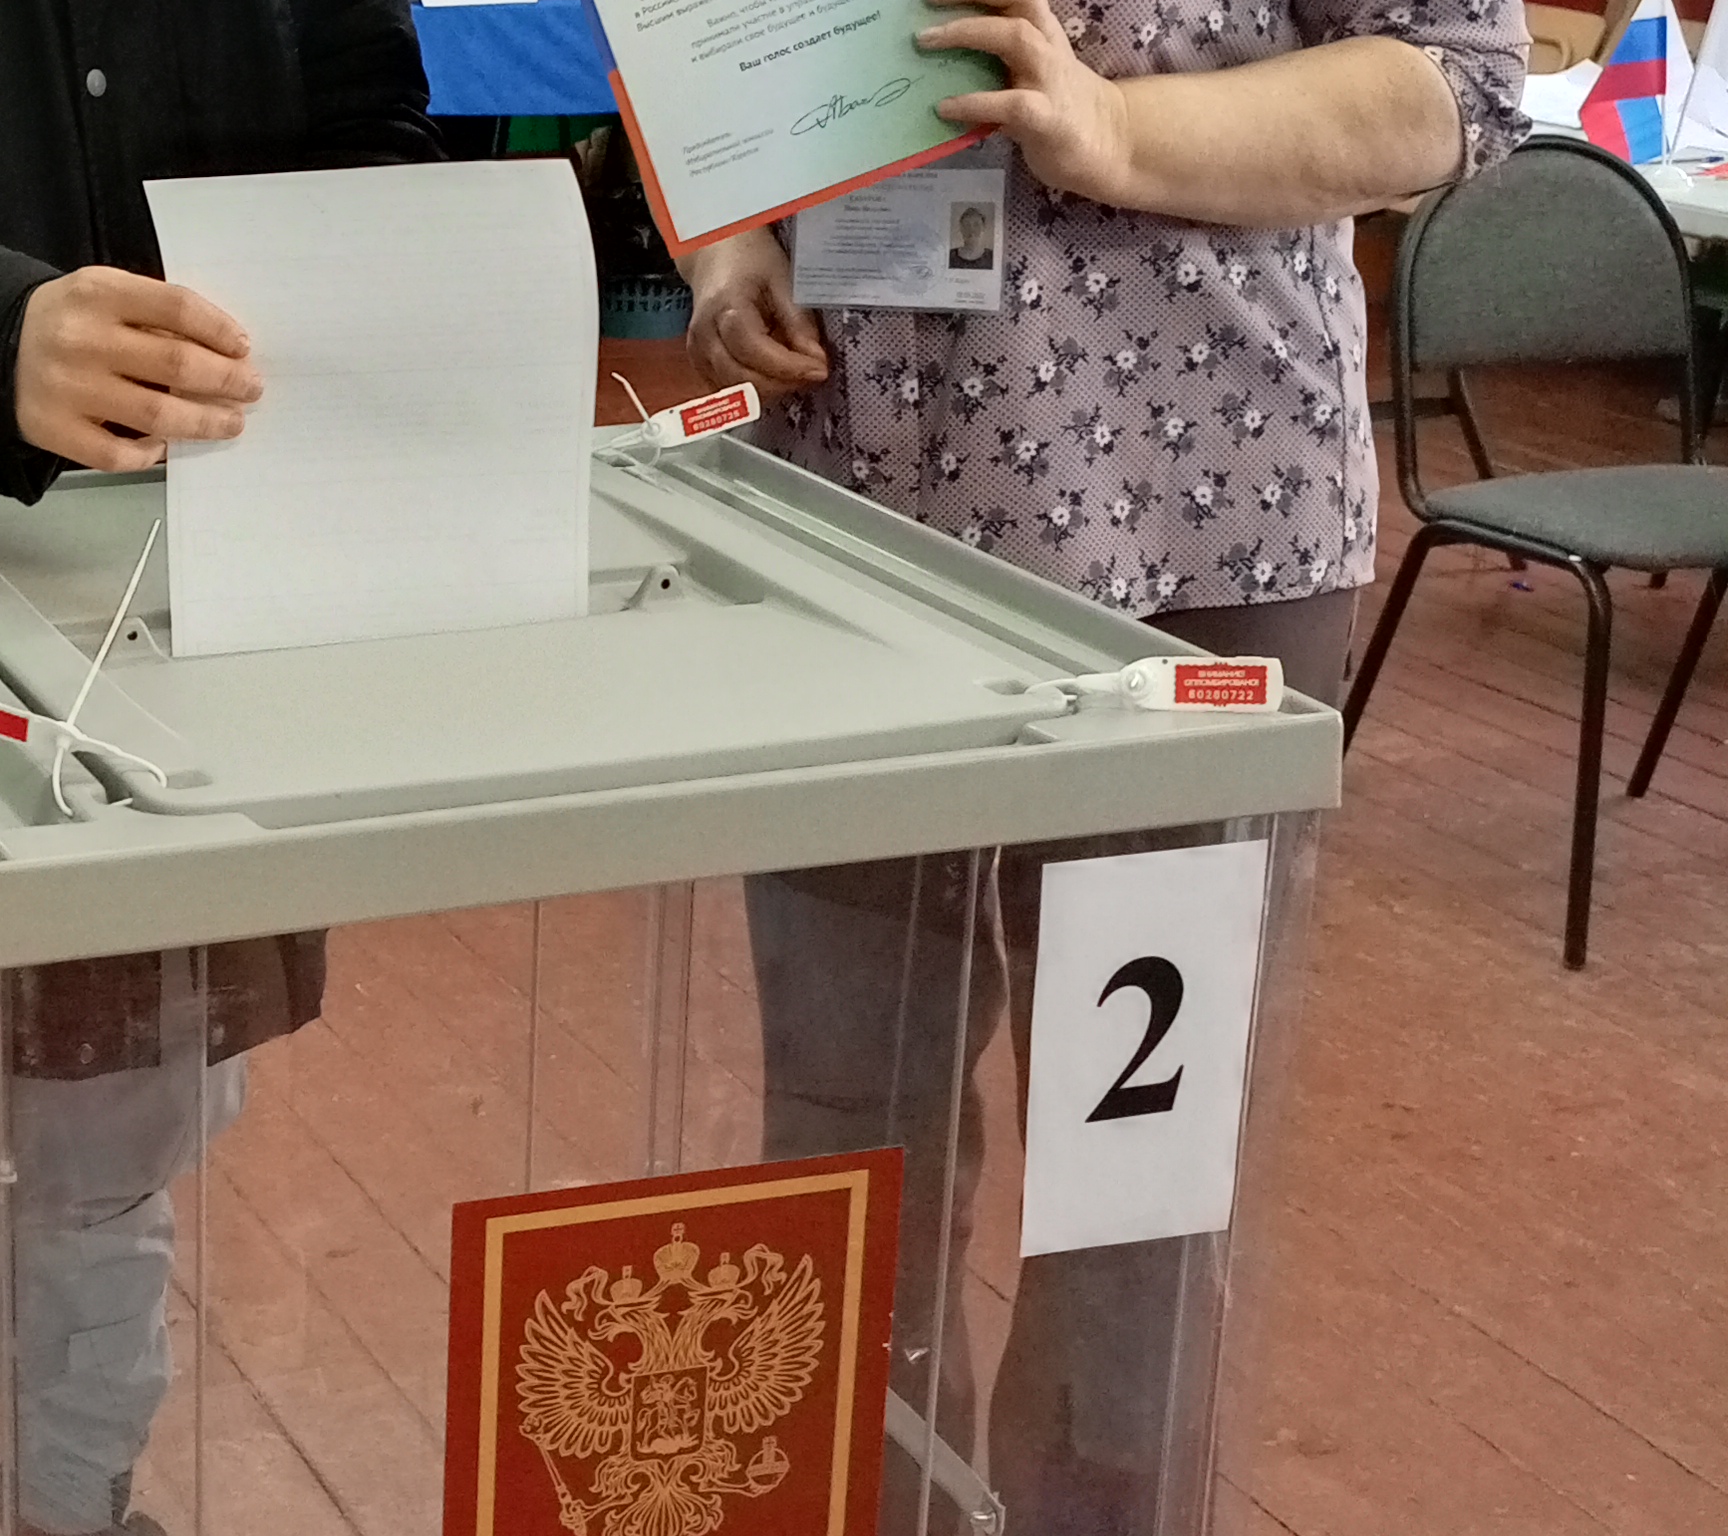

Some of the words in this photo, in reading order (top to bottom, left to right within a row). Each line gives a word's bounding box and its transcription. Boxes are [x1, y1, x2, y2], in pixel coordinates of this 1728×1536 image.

[738, 56, 762, 72] Ваш
[762, 45, 792, 63] голос
[791, 29, 832, 52] создает
[832, 9, 883, 37] будущее!
[1085, 956, 1184, 1123] 2
